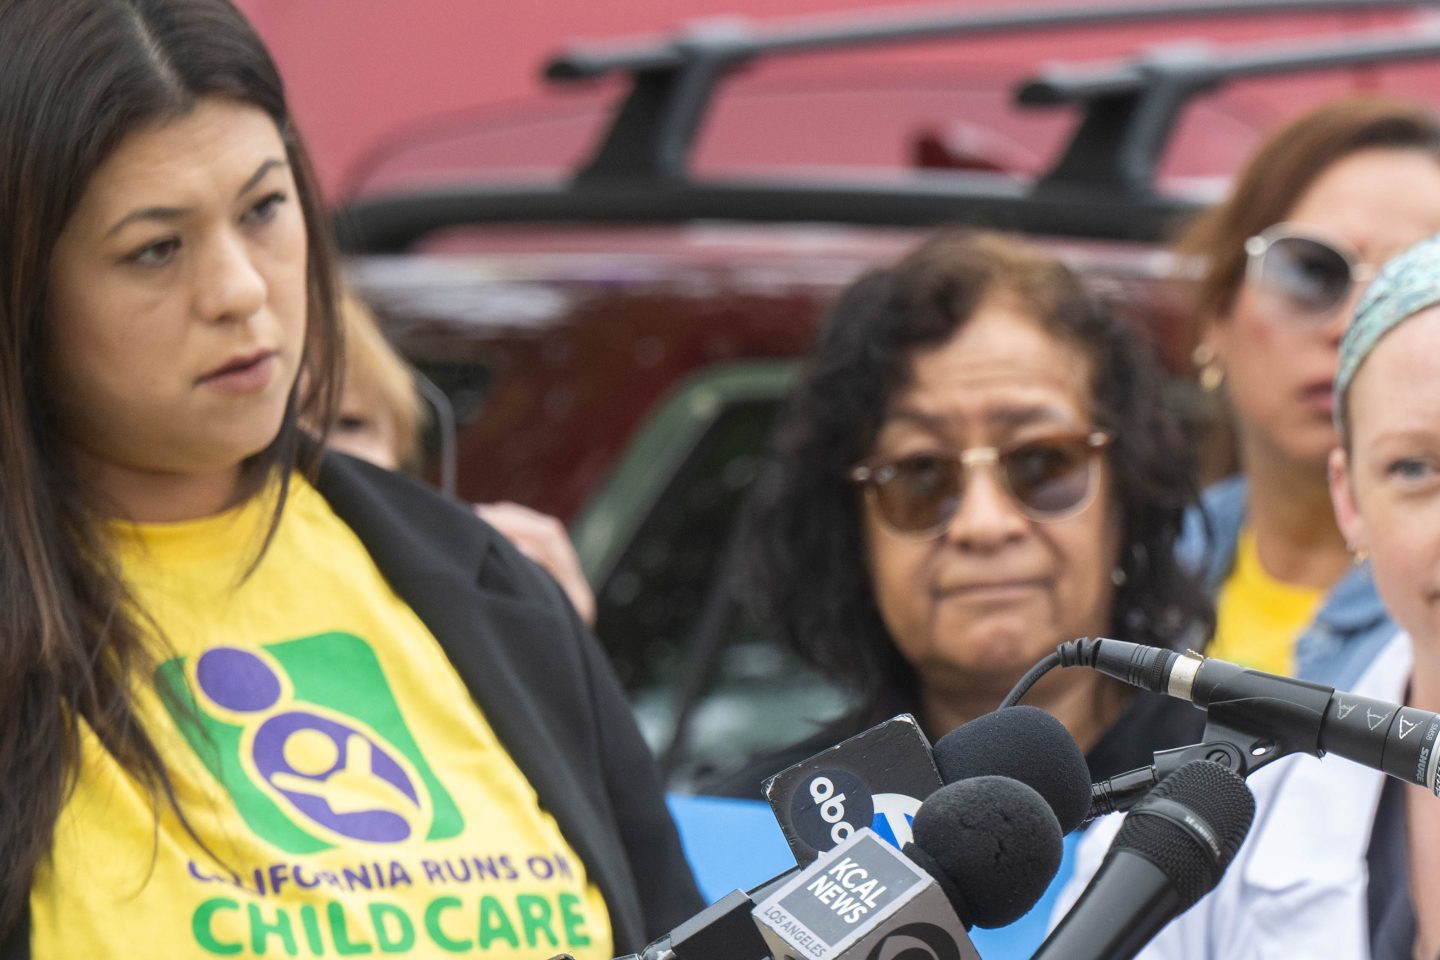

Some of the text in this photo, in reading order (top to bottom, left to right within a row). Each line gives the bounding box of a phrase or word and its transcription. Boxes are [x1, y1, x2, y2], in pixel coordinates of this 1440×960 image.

[1415, 722, 1439, 783] SM58 SHURE
[809, 776, 855, 846] abc
[421, 855, 520, 885] RUNS
[828, 857, 887, 909] KCAL
[806, 875, 868, 924] NEWS
[763, 905, 827, 958] LOS ANGELES
